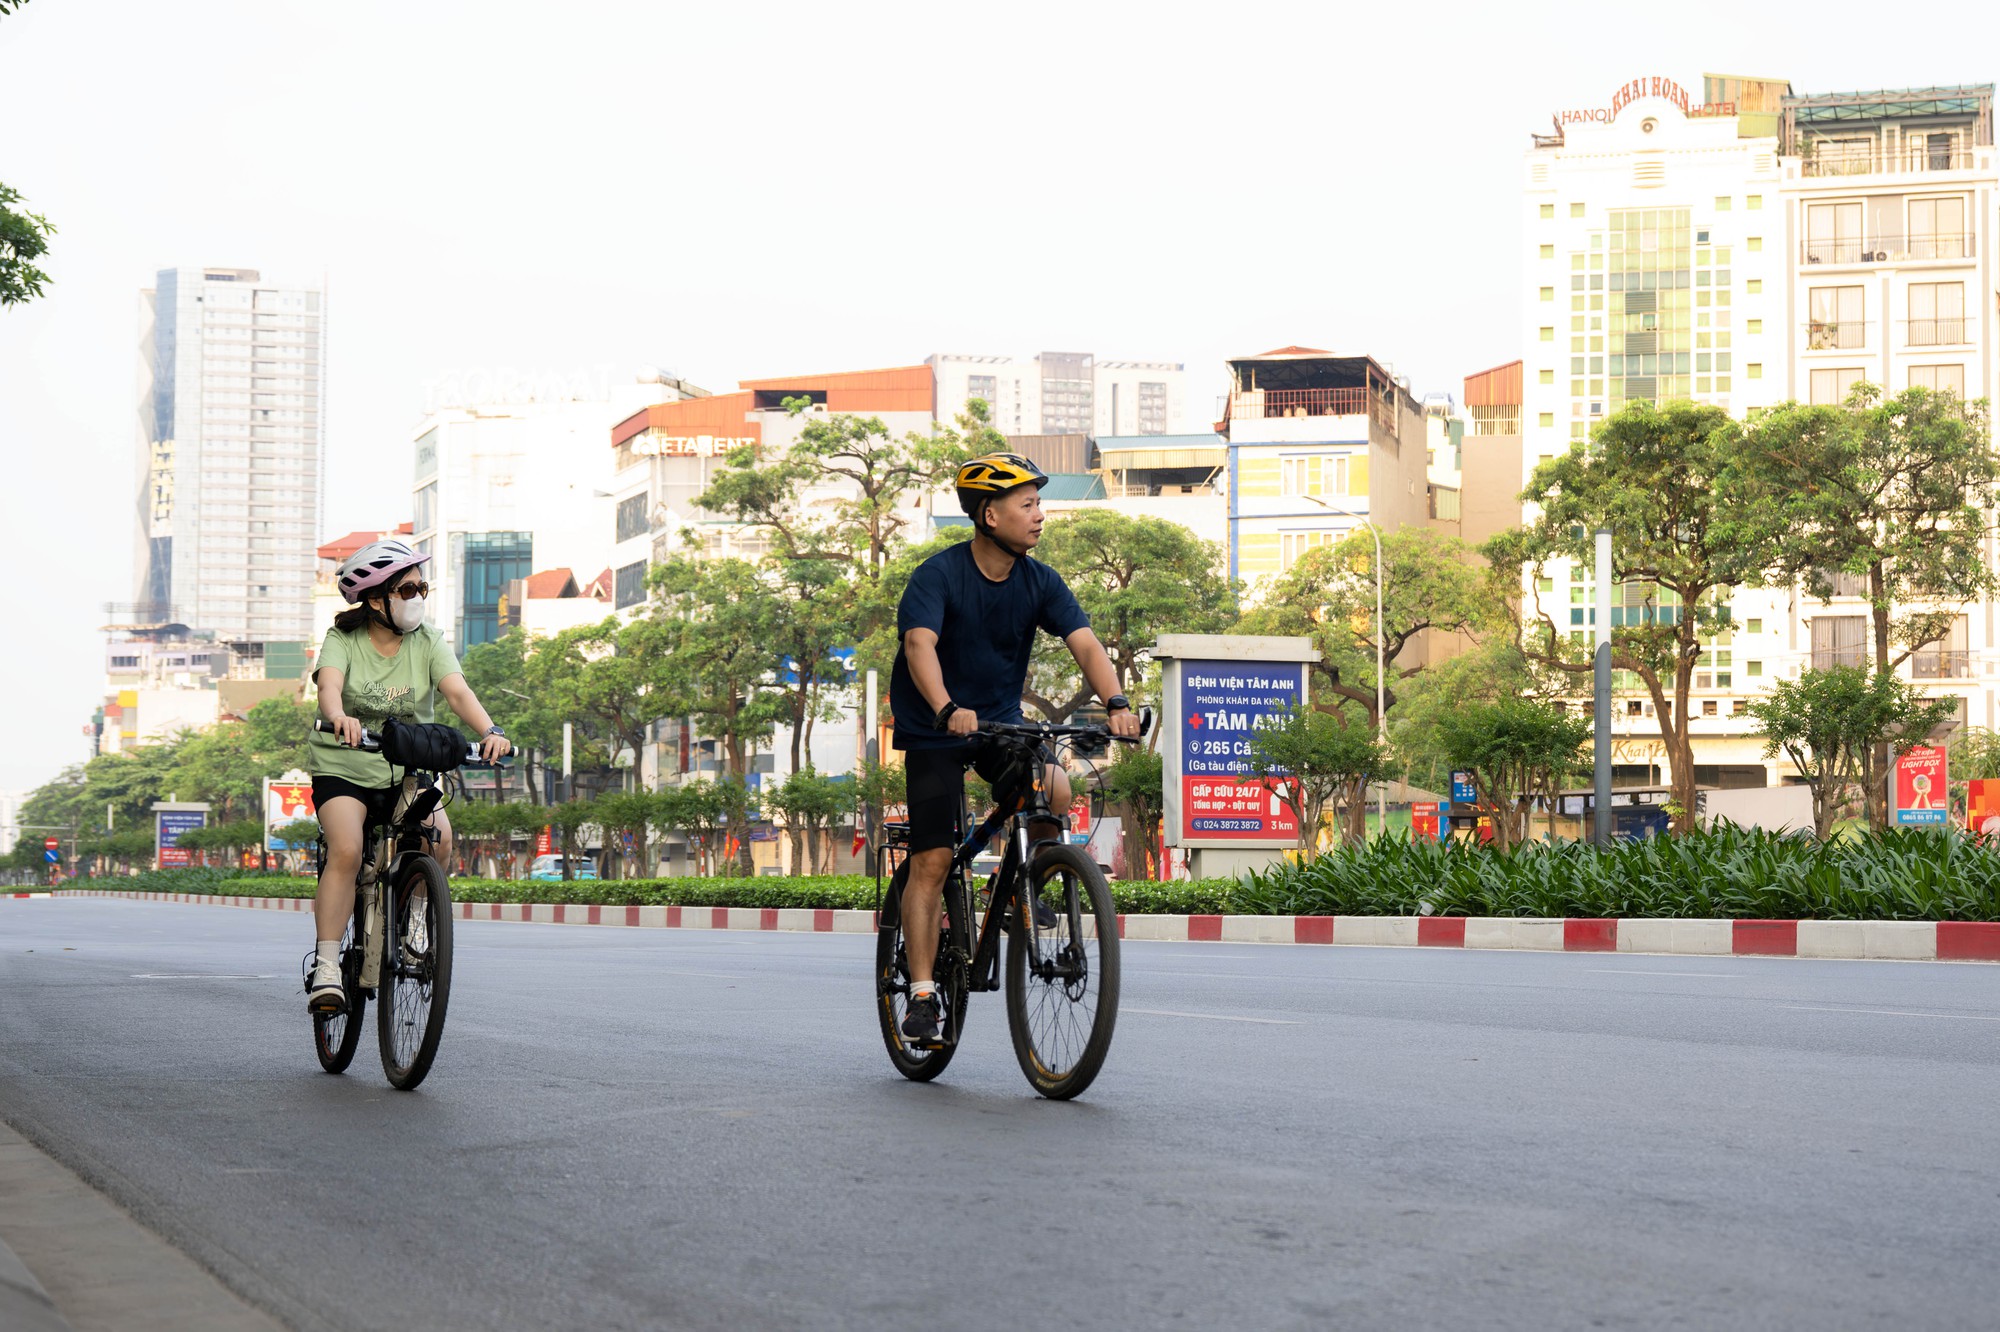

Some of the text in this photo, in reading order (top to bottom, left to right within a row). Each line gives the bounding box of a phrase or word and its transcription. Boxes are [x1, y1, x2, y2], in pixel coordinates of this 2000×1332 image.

[1612, 76, 1689, 118] KHAI HOAN
[1691, 101, 1736, 117] HOTEL
[1188, 675, 1294, 691] BỆNH VIỆN TÂM ANH
[1196, 695, 1224, 705] PHÒNG
[1226, 695, 1249, 705] KHÁM
[1251, 697, 1262, 705] ĐA
[1205, 709, 1247, 731] TÂM
[1203, 741, 1230, 755] 265
[1611, 739, 1646, 764] Khai
[1188, 760, 1206, 772] (Ga
[1208, 760, 1225, 772] tàu
[1226, 760, 1249, 773] điện
[1901, 759, 1941, 769] LIGHT BOX
[1192, 783, 1260, 798] CẤP CỨU 24/7
[1203, 820, 1260, 830] 024 3872 3872
[1271, 820, 1293, 830] 3 km
